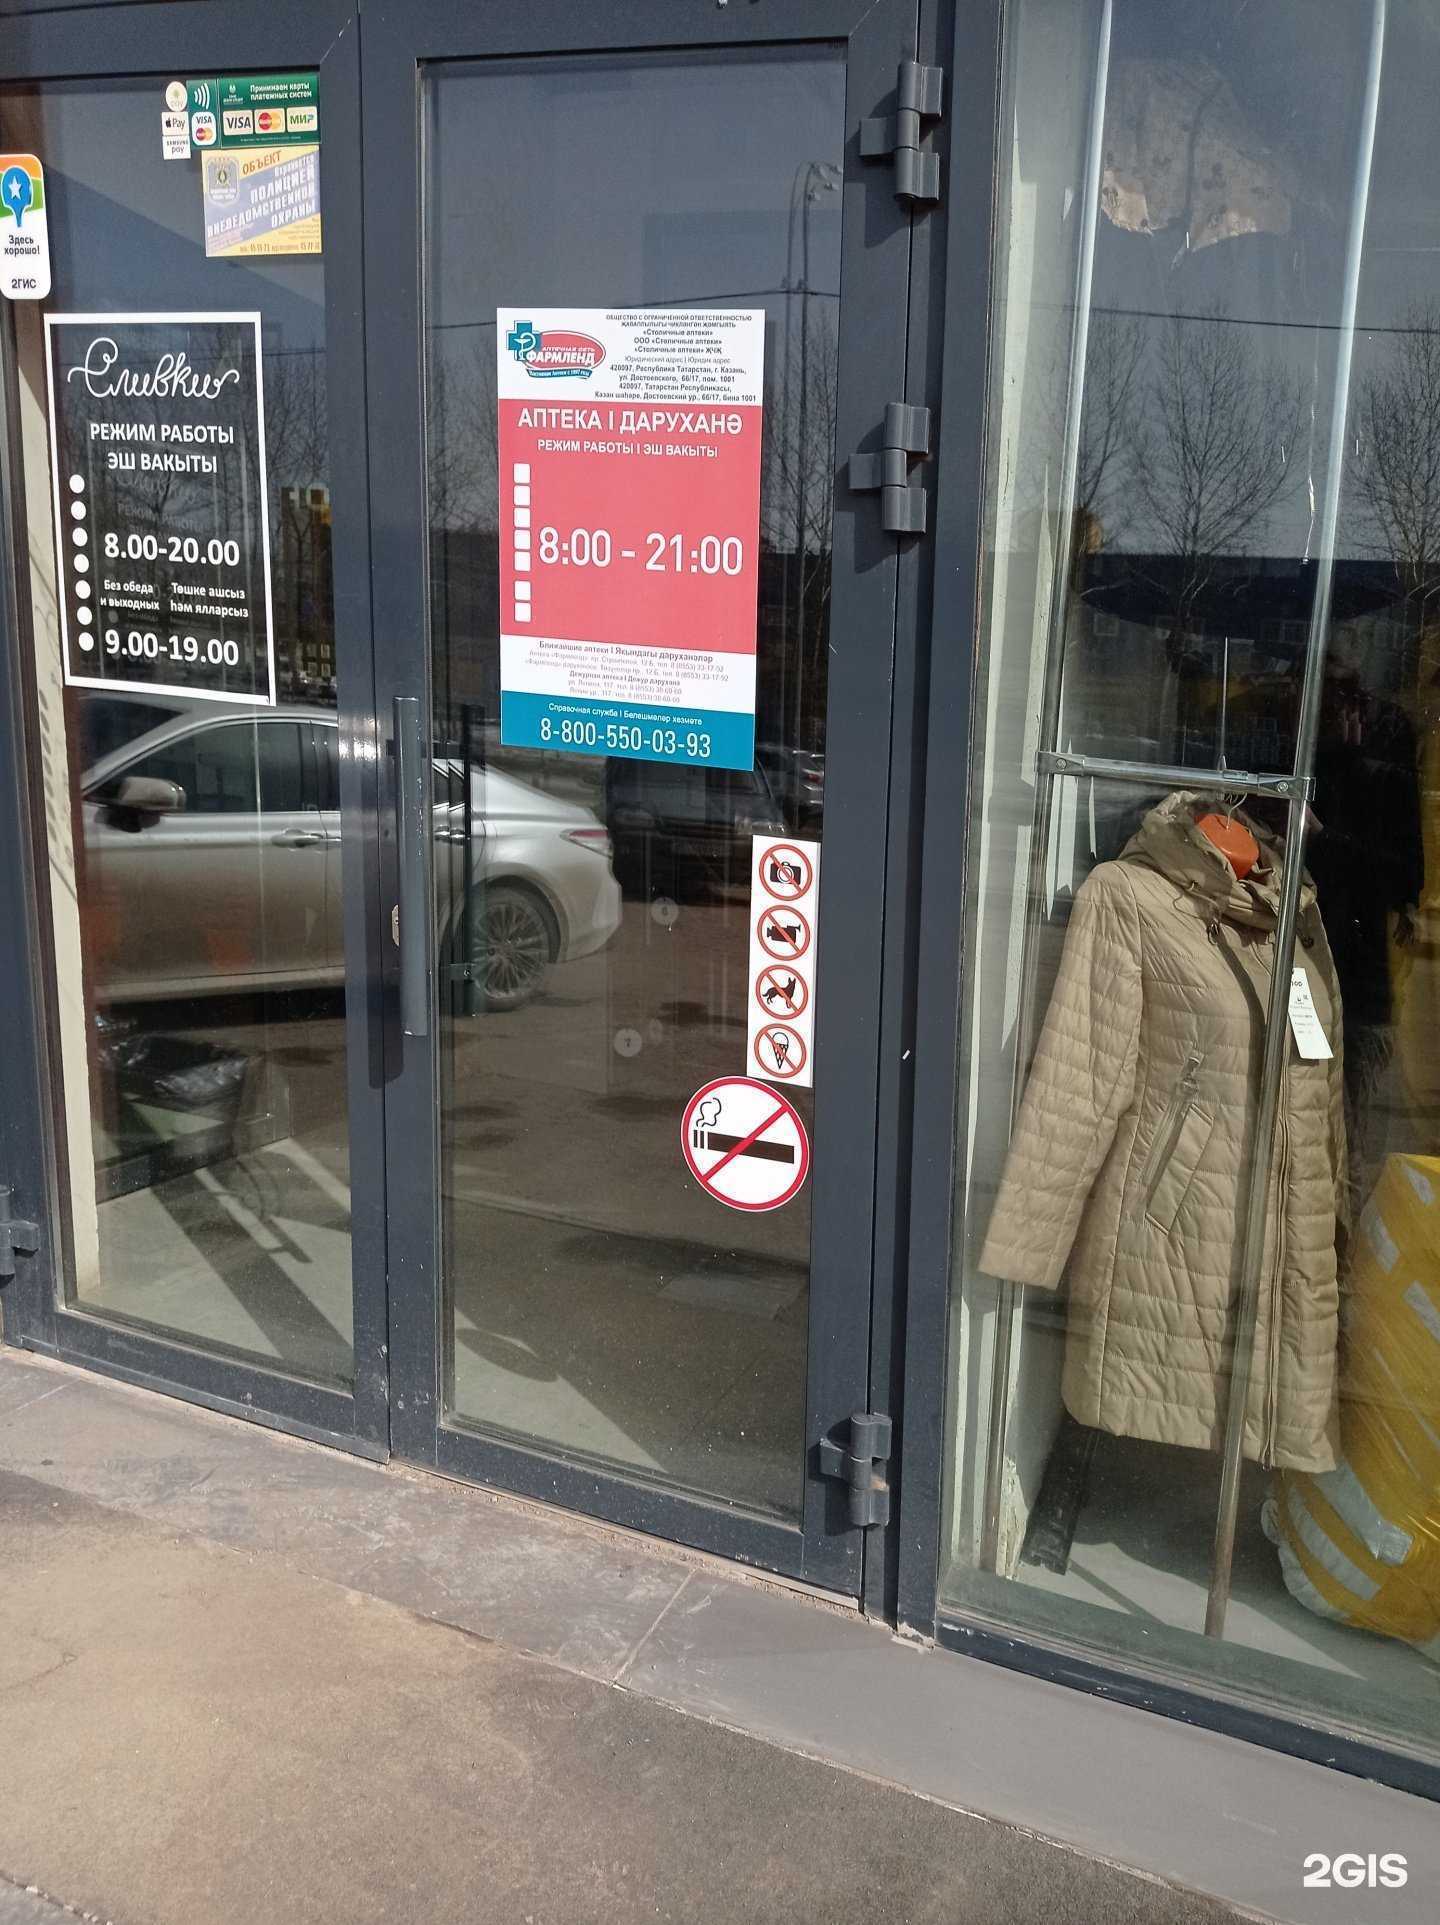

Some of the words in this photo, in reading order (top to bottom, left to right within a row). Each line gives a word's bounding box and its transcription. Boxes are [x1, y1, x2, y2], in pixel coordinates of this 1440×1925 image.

[289, 82, 310, 90] карты
[289, 90, 312, 98] систем
[173, 117, 185, 130] Pay
[196, 116, 212, 124] VISA
[226, 116, 251, 129] VISA
[290, 114, 314, 125] МИР
[172, 146, 184, 154] pay
[242, 150, 282, 175] ОБЪЕКТ
[271, 198, 316, 228] ОХРАНЫ
[8, 235, 34, 246] Здесь
[4, 245, 40, 257] хорошо!
[11, 278, 37, 289] 2ГИС
[526, 350, 595, 366] ФАРМЛЕНД
[67, 337, 240, 399] Сливки
[636, 365, 675, 373] Республика
[677, 366, 713, 374] Татарстан,
[518, 408, 602, 429] АПТЕКА
[619, 411, 743, 435] ДАРУХАНӘ
[90, 423, 156, 441] РЕЖИМ
[161, 424, 234, 444] РАБОТЫ
[537, 439, 581, 452] РЕЖИМ
[583, 441, 634, 454] РАБОТЫ
[644, 443, 663, 456] ЭШ
[666, 444, 718, 457] ВАКЫТЫ
[107, 452, 136, 470] ЭШ
[141, 453, 217, 473] ВАКЫТЫ
[104, 532, 240, 567] 8.00-20.00
[539, 526, 611, 568] 8:00
[645, 532, 743, 576] 21:00
[104, 579, 121, 591] Без
[123, 580, 154, 595] обеда
[208, 587, 246, 600] ашсыз
[108, 598, 160, 611] выходных
[195, 604, 249, 618] ялларсыз
[104, 629, 239, 666] 9.00-19.00
[584, 645, 608, 654] аптеки
[549, 702, 590, 715] Справочная
[592, 708, 618, 718] служба
[540, 717, 711, 758] 8-800-550-03-93
